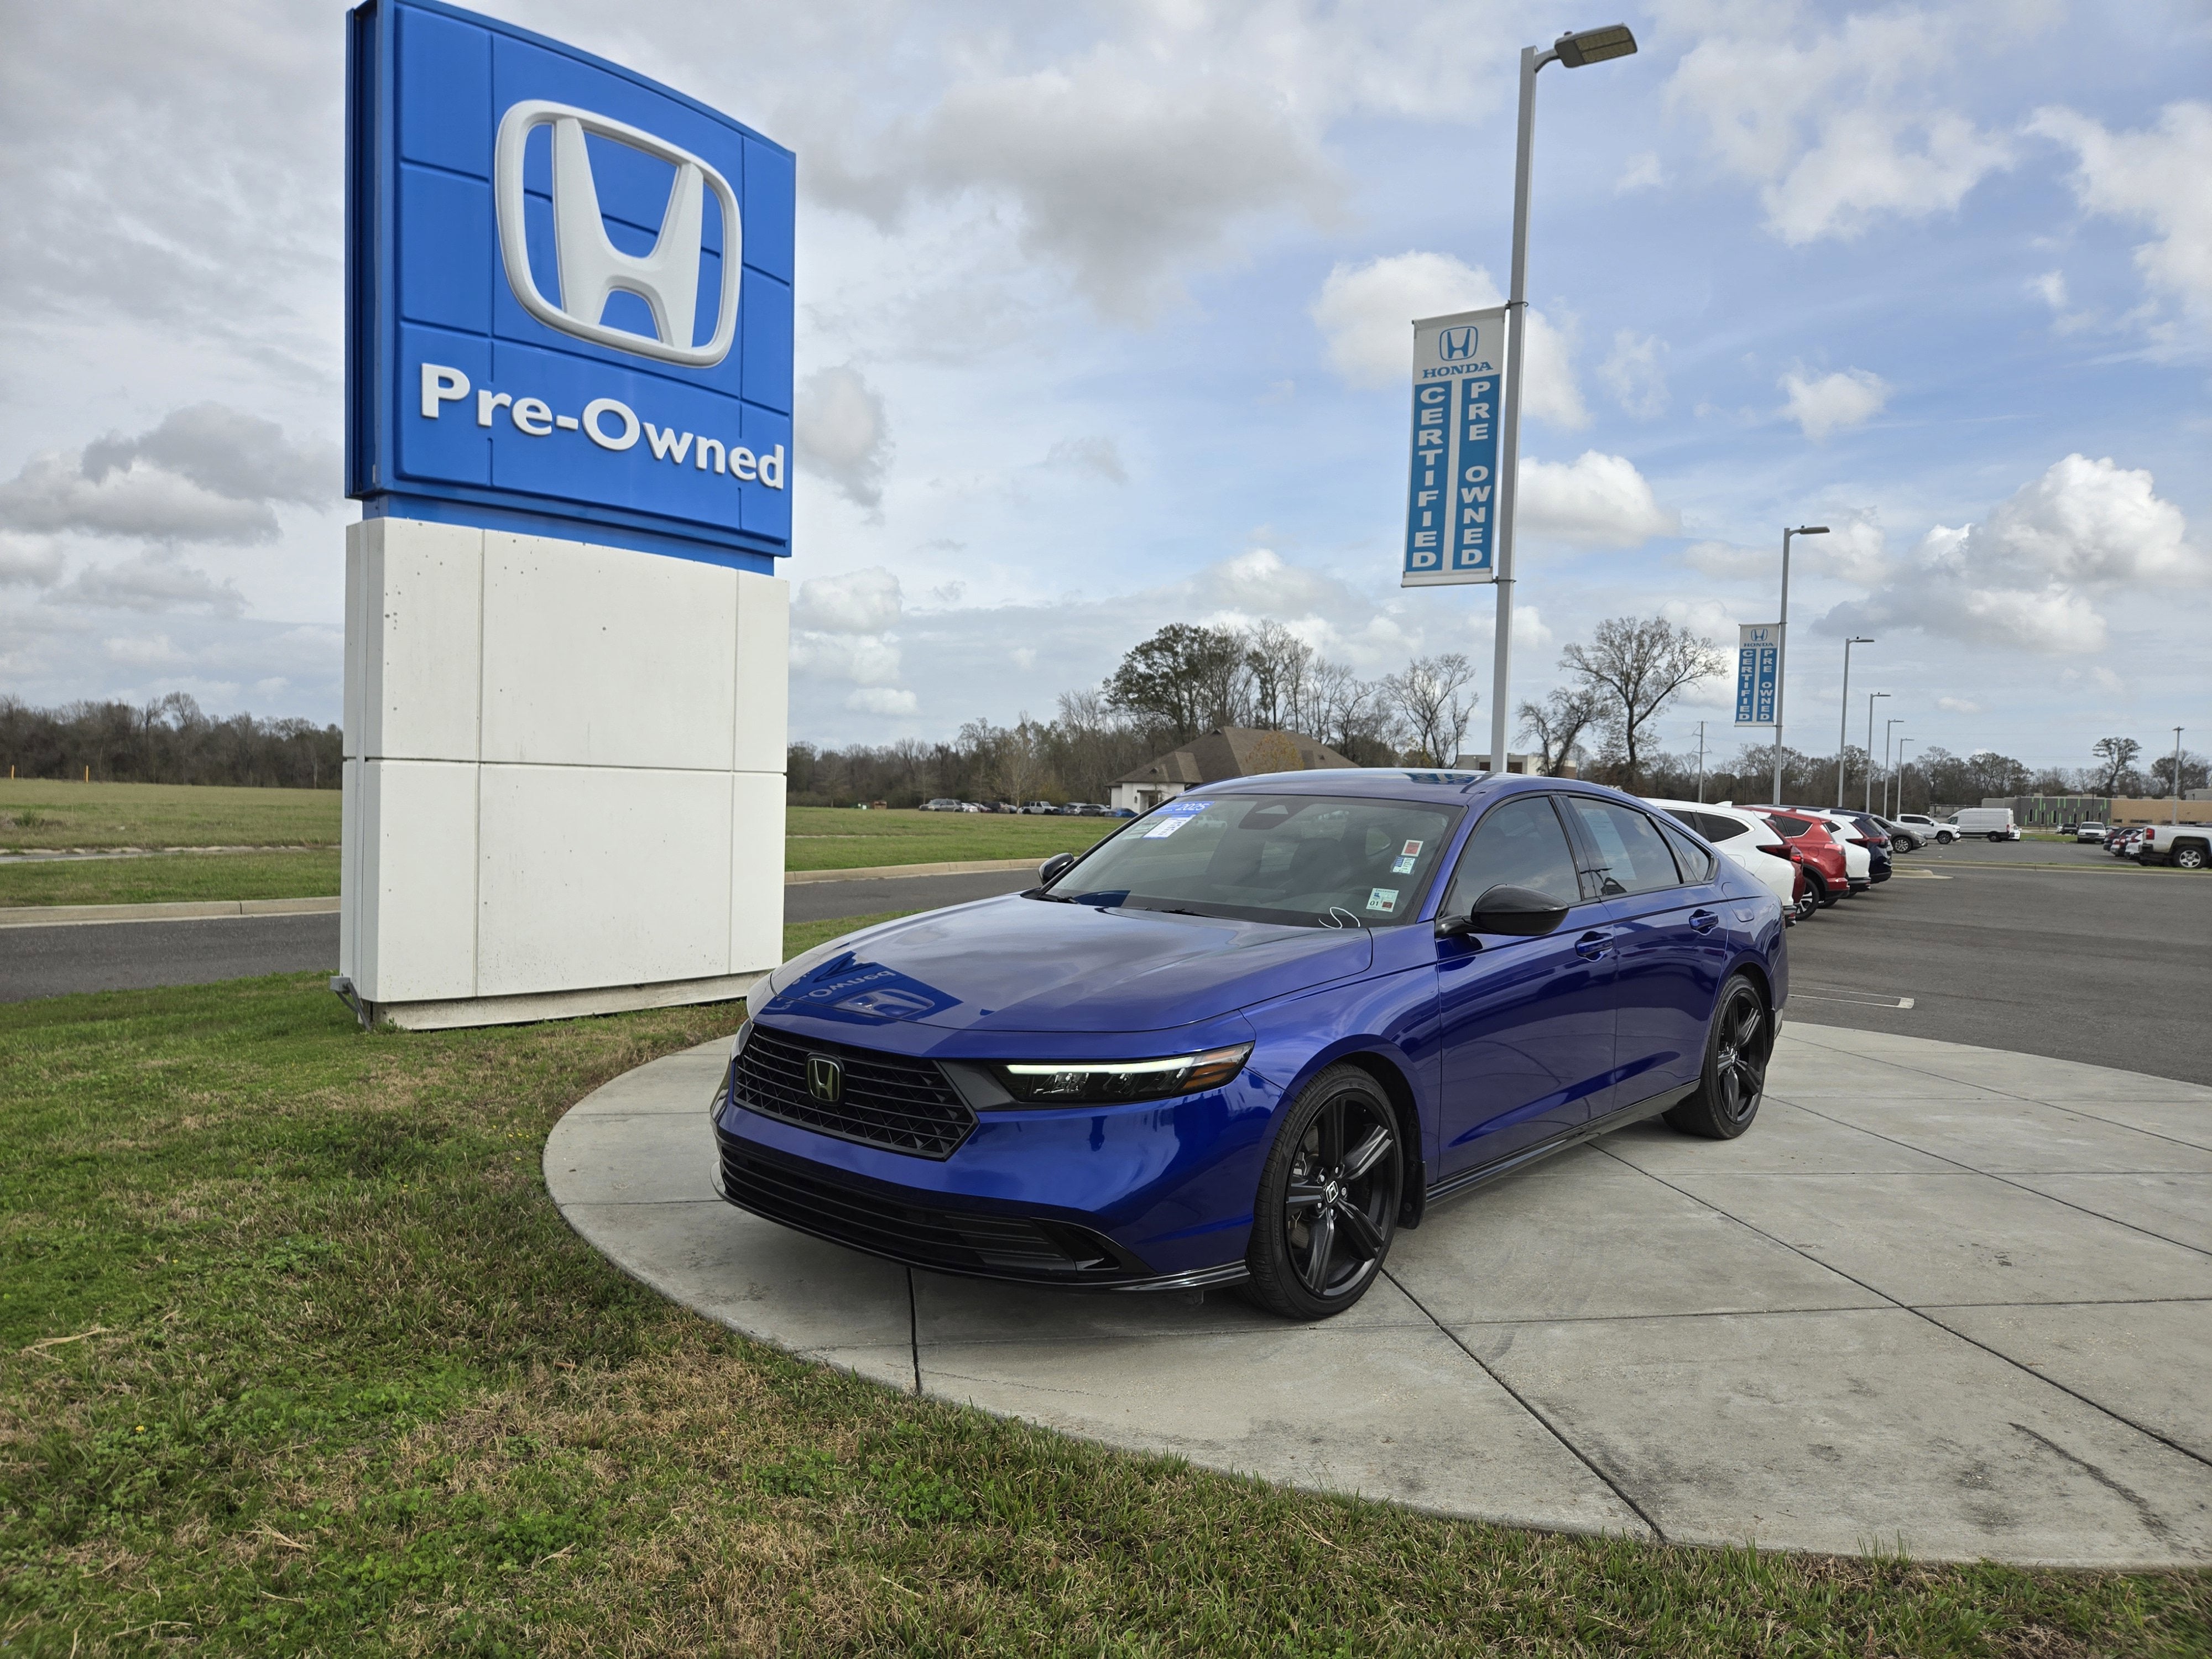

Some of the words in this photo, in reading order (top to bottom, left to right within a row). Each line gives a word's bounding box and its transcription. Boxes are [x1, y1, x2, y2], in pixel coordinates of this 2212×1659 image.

[1422, 362, 1493, 378] HONDA
[421, 363, 785, 490] Pre-Owned
[1468, 381, 1490, 441] PRE
[1412, 387, 1446, 568] CERTIFIED
[1460, 466, 1491, 566] OWNED
[1739, 650, 1754, 721] CERTIFIED
[1763, 650, 1773, 672] PRE
[1760, 681, 1773, 721] OWNED
